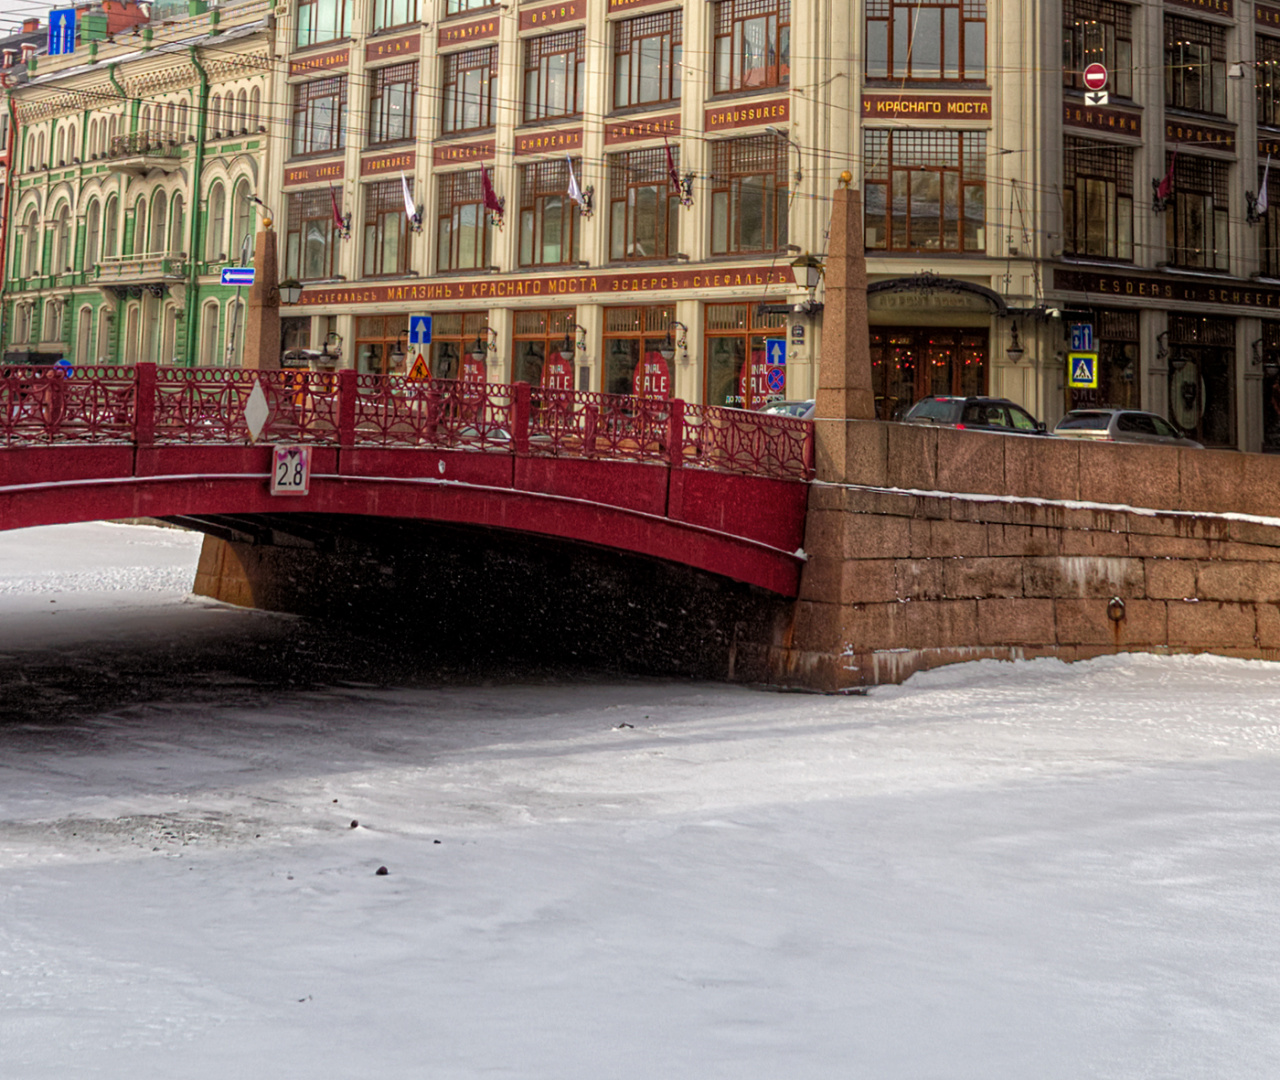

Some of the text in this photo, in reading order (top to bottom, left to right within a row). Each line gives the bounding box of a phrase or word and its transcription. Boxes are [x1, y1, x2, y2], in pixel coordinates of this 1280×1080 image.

[531, 5, 576, 24] ОБУВЬ
[711, 104, 786, 126] CHAUSSURES
[863, 100, 989, 114] У КРАСНАГО МОСТА
[1065, 107, 1137, 131] ЗОНТИКИ
[521, 133, 579, 151] CHAPEAUX
[1167, 125, 1232, 146] СОРОЧКИ
[387, 284, 452, 300] МАГАЗИНЪ
[458, 284, 465, 298] У
[471, 280, 541, 297] КРАСНАГО
[548, 277, 598, 293] МОСТА
[612, 277, 679, 291] ЭСДЕРСЪ
[693, 272, 787, 288] СХЕФАЛЬСЪ
[1099, 279, 1172, 298] ESDERS
[751, 364, 768, 375] INAL
[277, 462, 303, 486] 2.8
